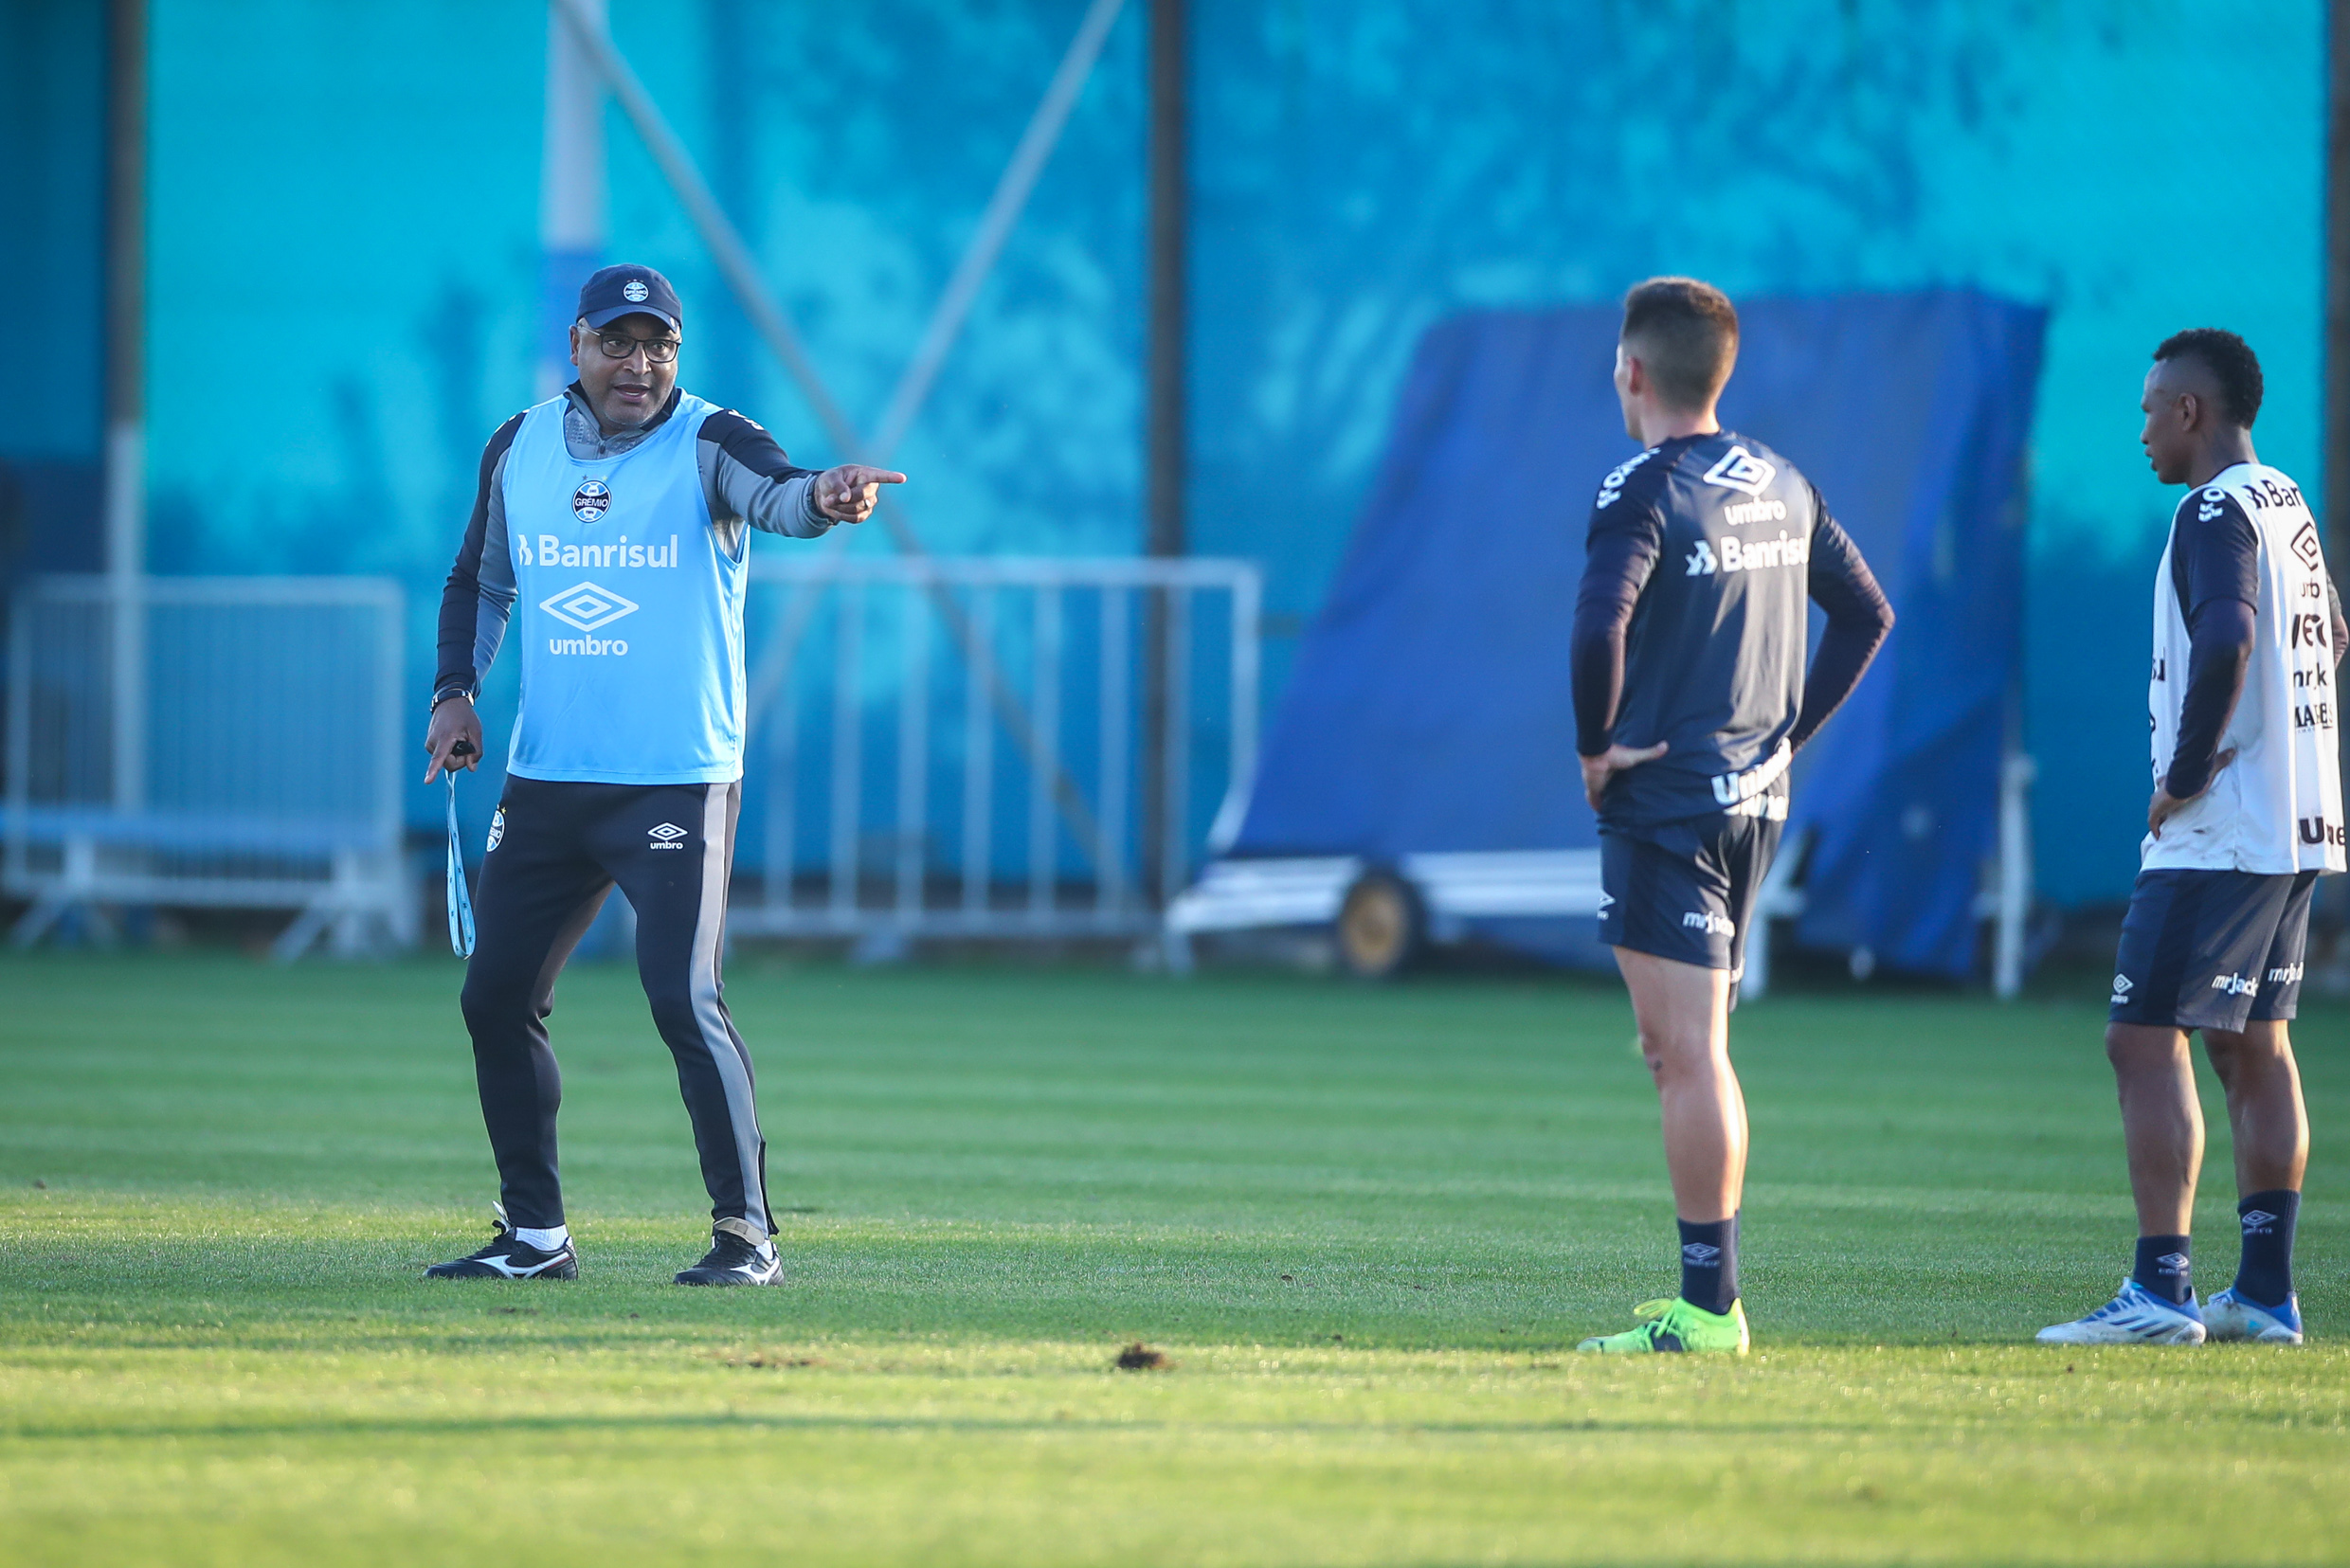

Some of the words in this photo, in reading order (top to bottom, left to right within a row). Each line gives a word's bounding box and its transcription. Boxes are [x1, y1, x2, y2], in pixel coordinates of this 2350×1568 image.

[575, 496, 608, 508] GRÊMIO
[1724, 496, 1787, 526] umbro
[538, 534, 678, 568] Banrisul
[549, 635, 629, 657] umbro
[650, 840, 684, 850] umbro
